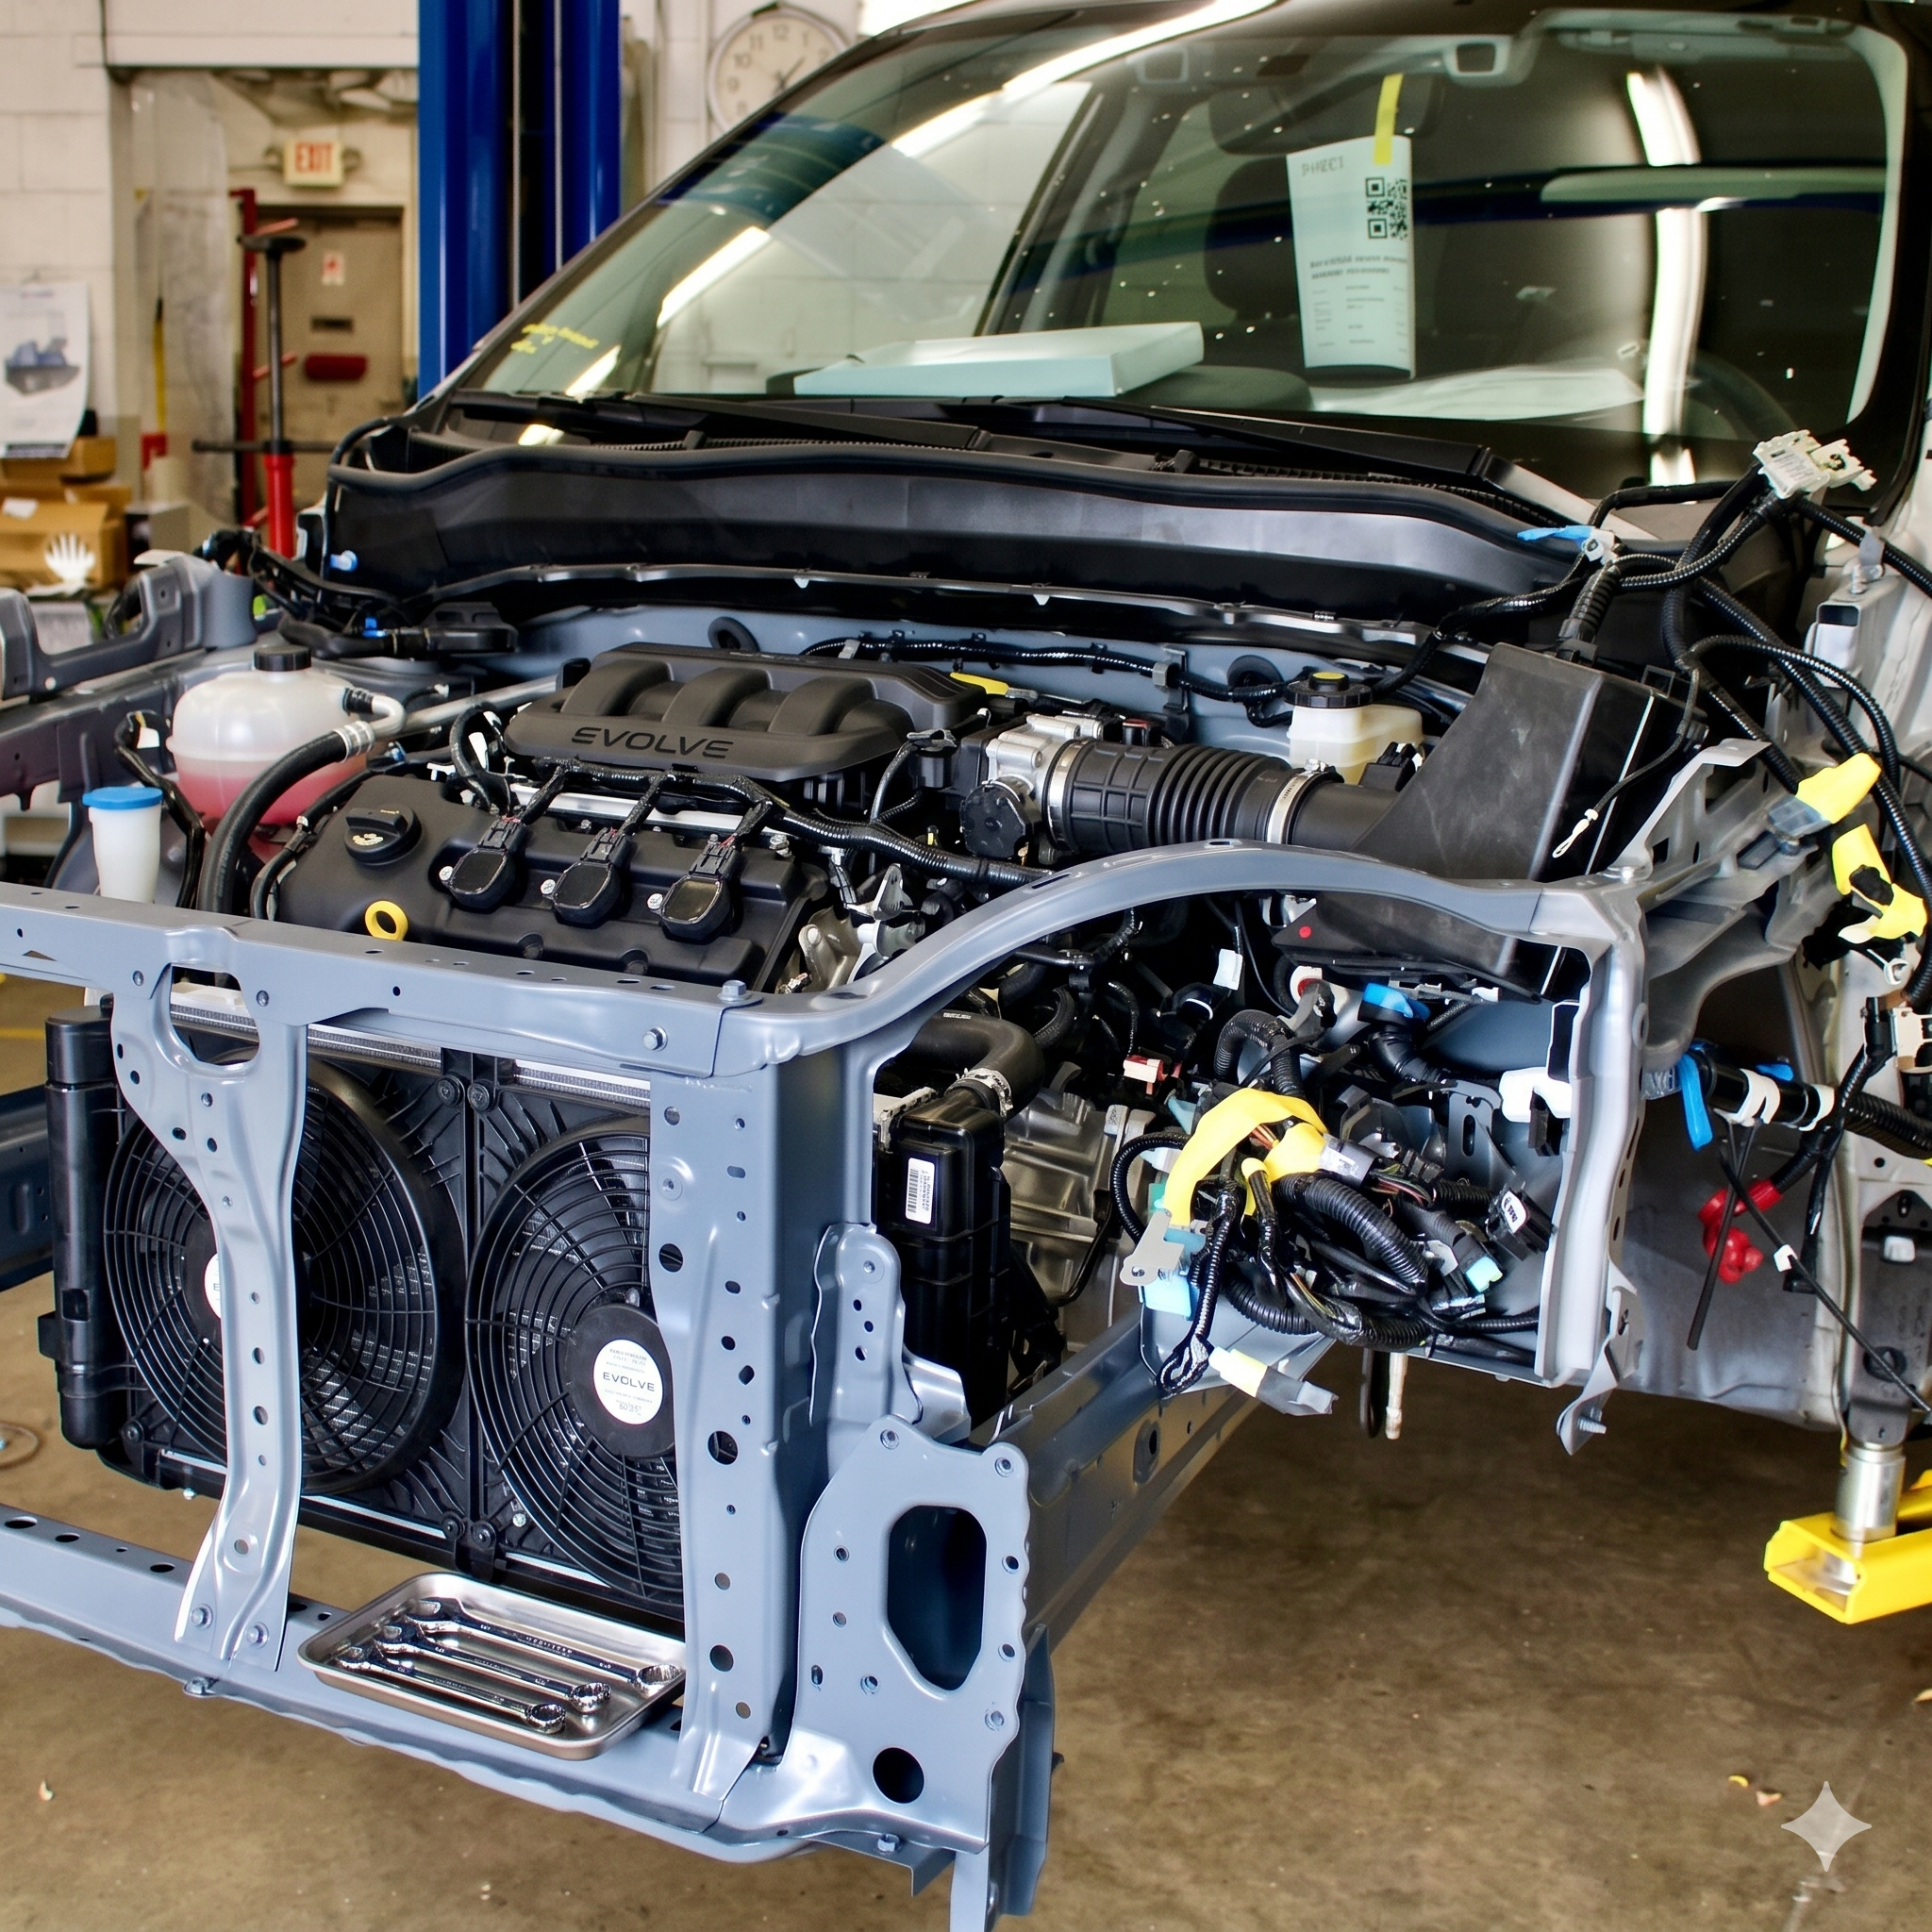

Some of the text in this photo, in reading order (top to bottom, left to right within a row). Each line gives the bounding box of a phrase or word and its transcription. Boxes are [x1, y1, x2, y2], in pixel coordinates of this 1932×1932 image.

[295, 141, 333, 174] EXIT
[571, 726, 734, 759] EVOLVE
[603, 1372, 656, 1392] EVOLVE
